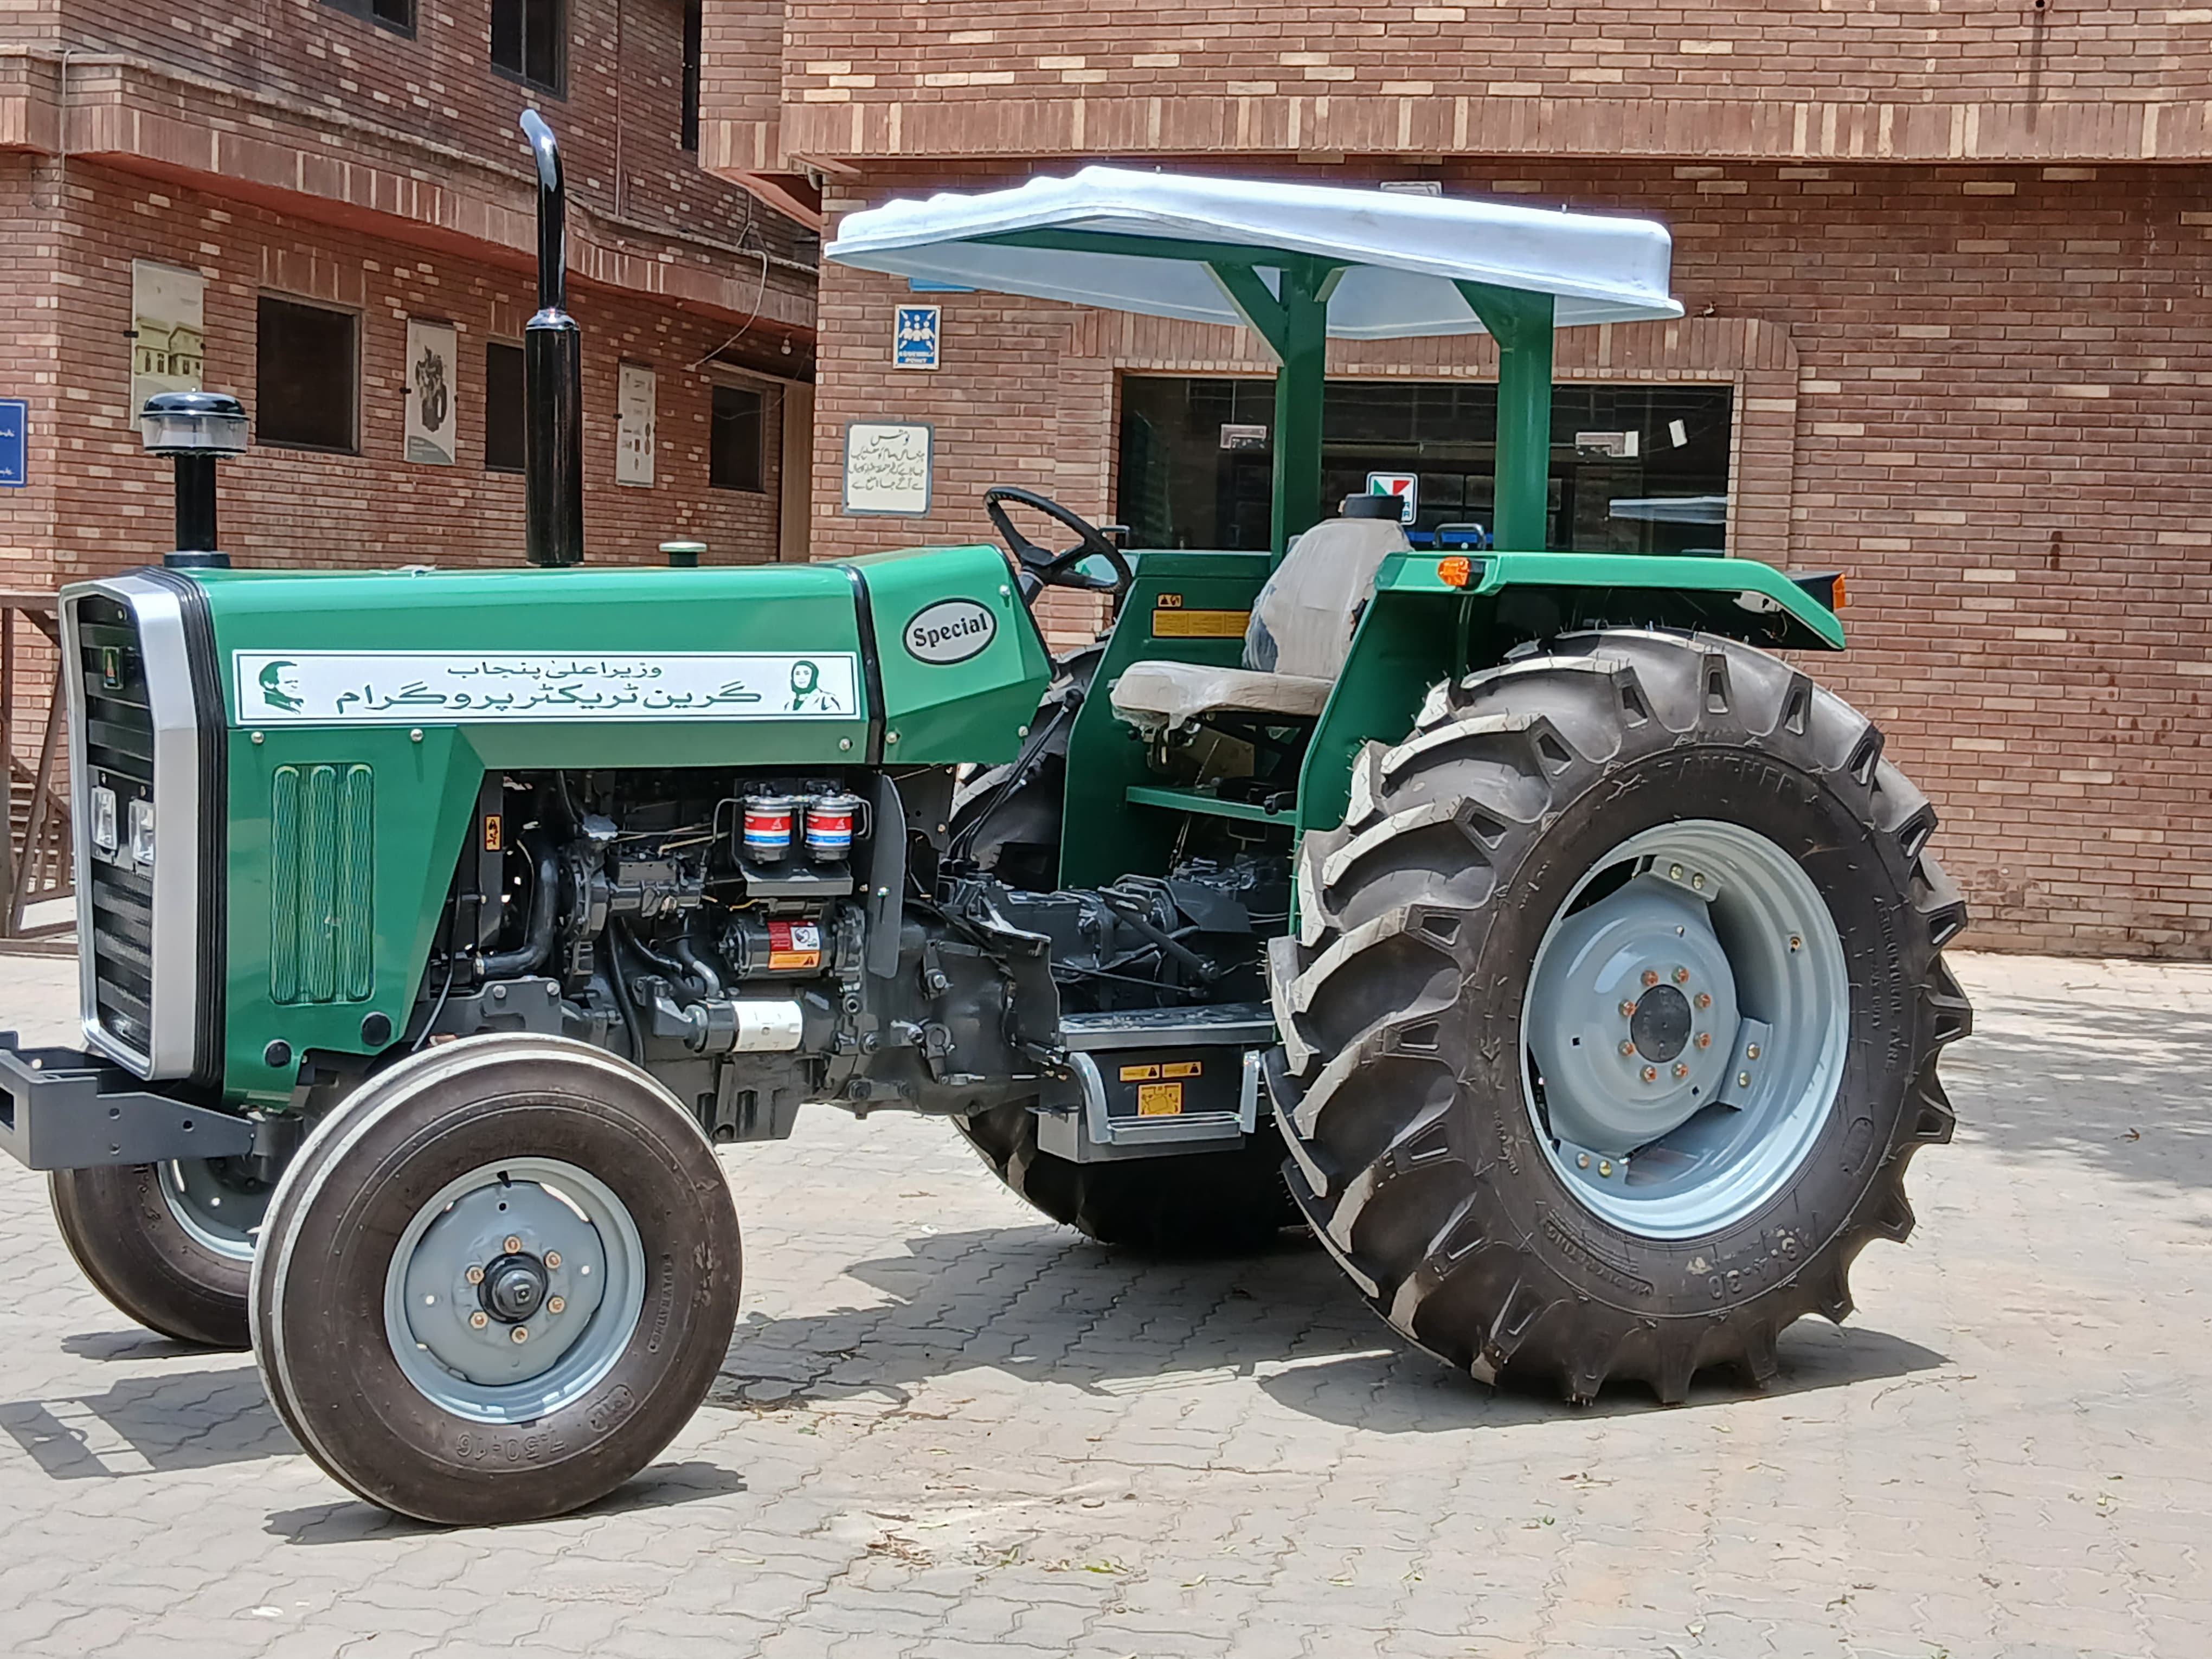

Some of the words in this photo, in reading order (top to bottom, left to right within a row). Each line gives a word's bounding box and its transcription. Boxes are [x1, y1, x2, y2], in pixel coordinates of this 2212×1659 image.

[913, 613, 988, 648] Special
[447, 661, 541, 679] پنجاب
[336, 681, 513, 715] پروگرام
[512, 683, 639, 709] ٹریکٹر
[642, 681, 762, 709] گرین
[456, 1423, 565, 1461] 7.50-16
